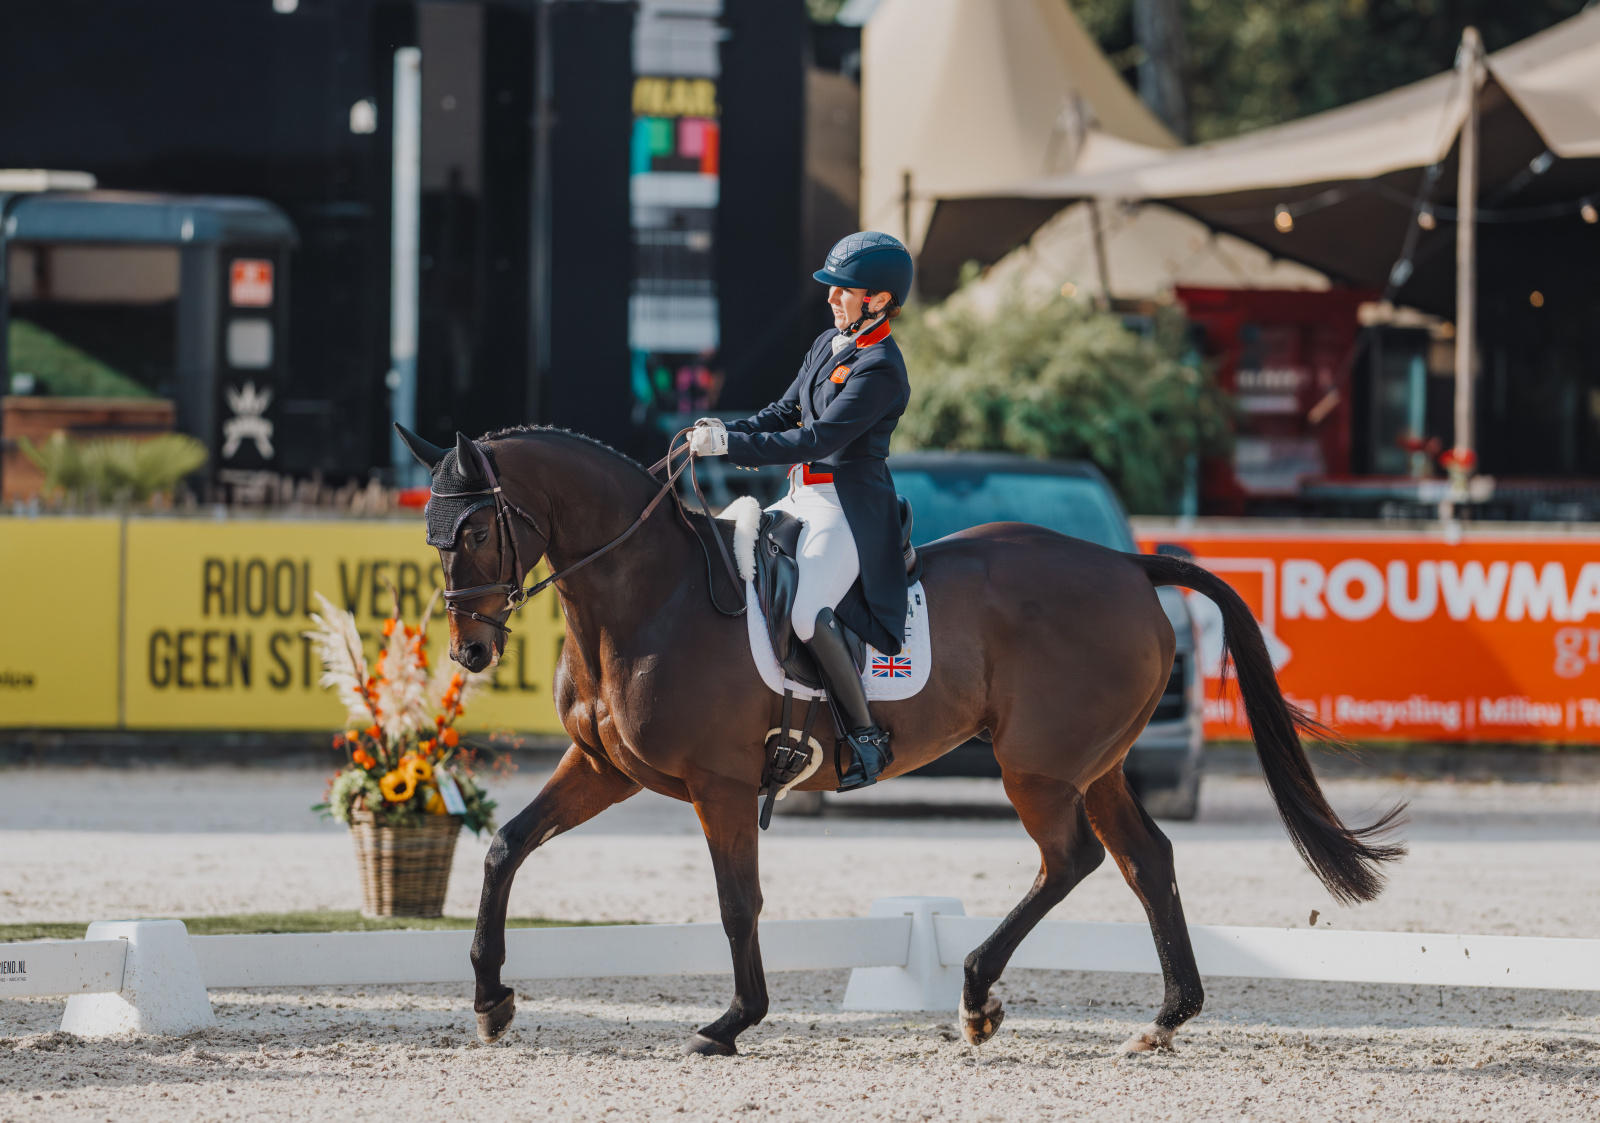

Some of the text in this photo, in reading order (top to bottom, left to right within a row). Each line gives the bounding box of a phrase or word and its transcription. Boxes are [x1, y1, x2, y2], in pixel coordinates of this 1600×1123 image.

[202, 556, 317, 619] RIOOL
[148, 630, 252, 690] GEEN
[1337, 694, 1461, 731] Recycling
[1479, 696, 1562, 726] Milieu
[0, 960, 26, 974] IEND.NL
